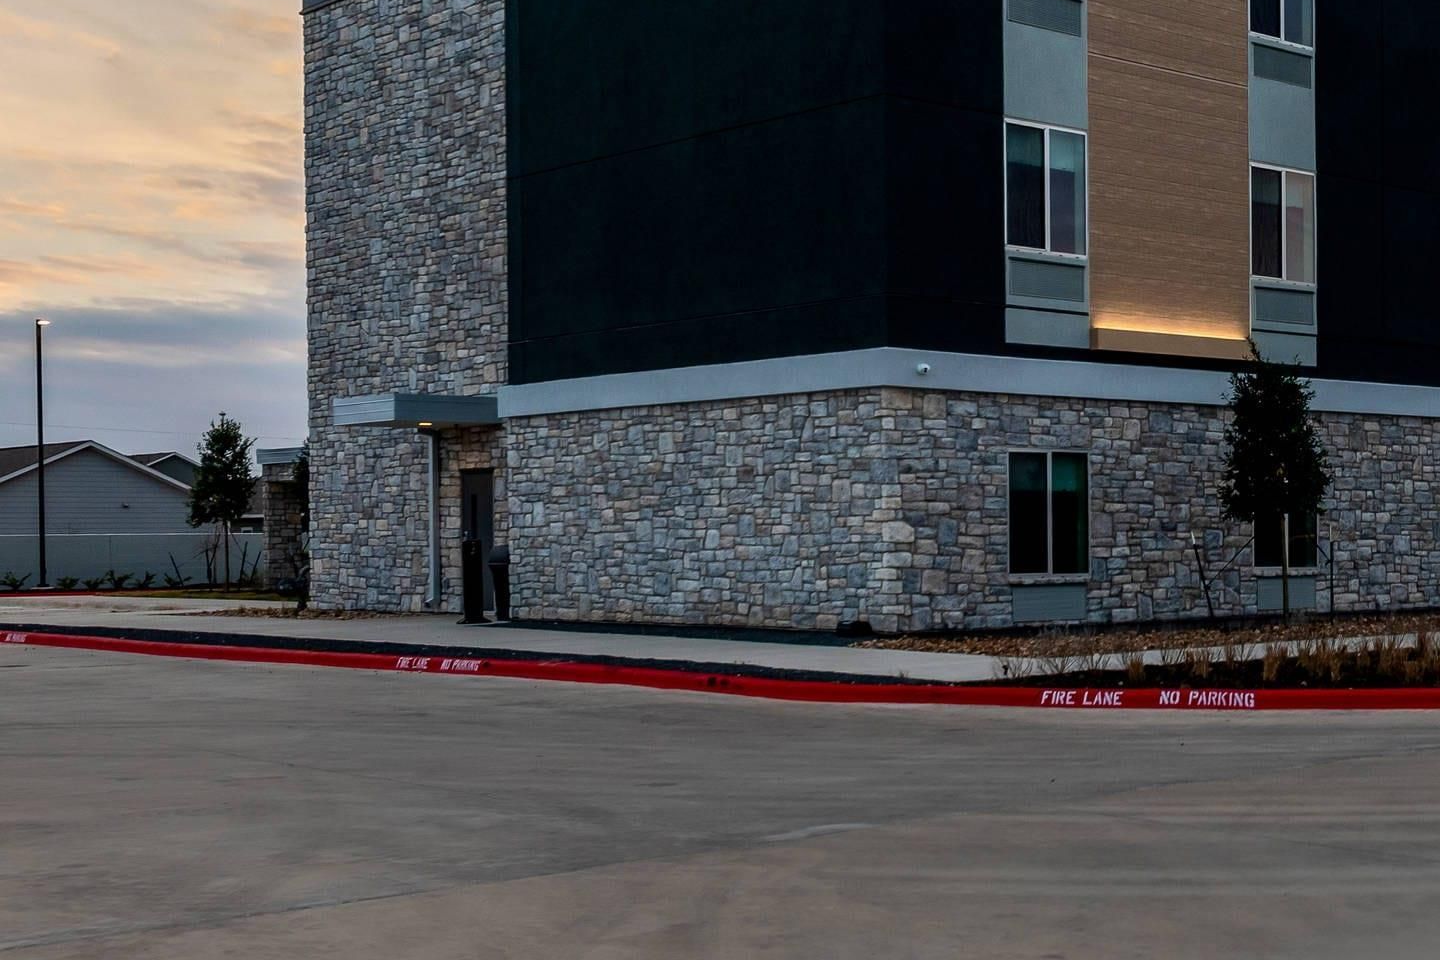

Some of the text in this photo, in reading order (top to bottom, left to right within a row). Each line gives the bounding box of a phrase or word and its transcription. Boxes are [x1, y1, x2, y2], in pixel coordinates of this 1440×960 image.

[1040, 690, 1256, 709] FIRE LANE NO PARKING
